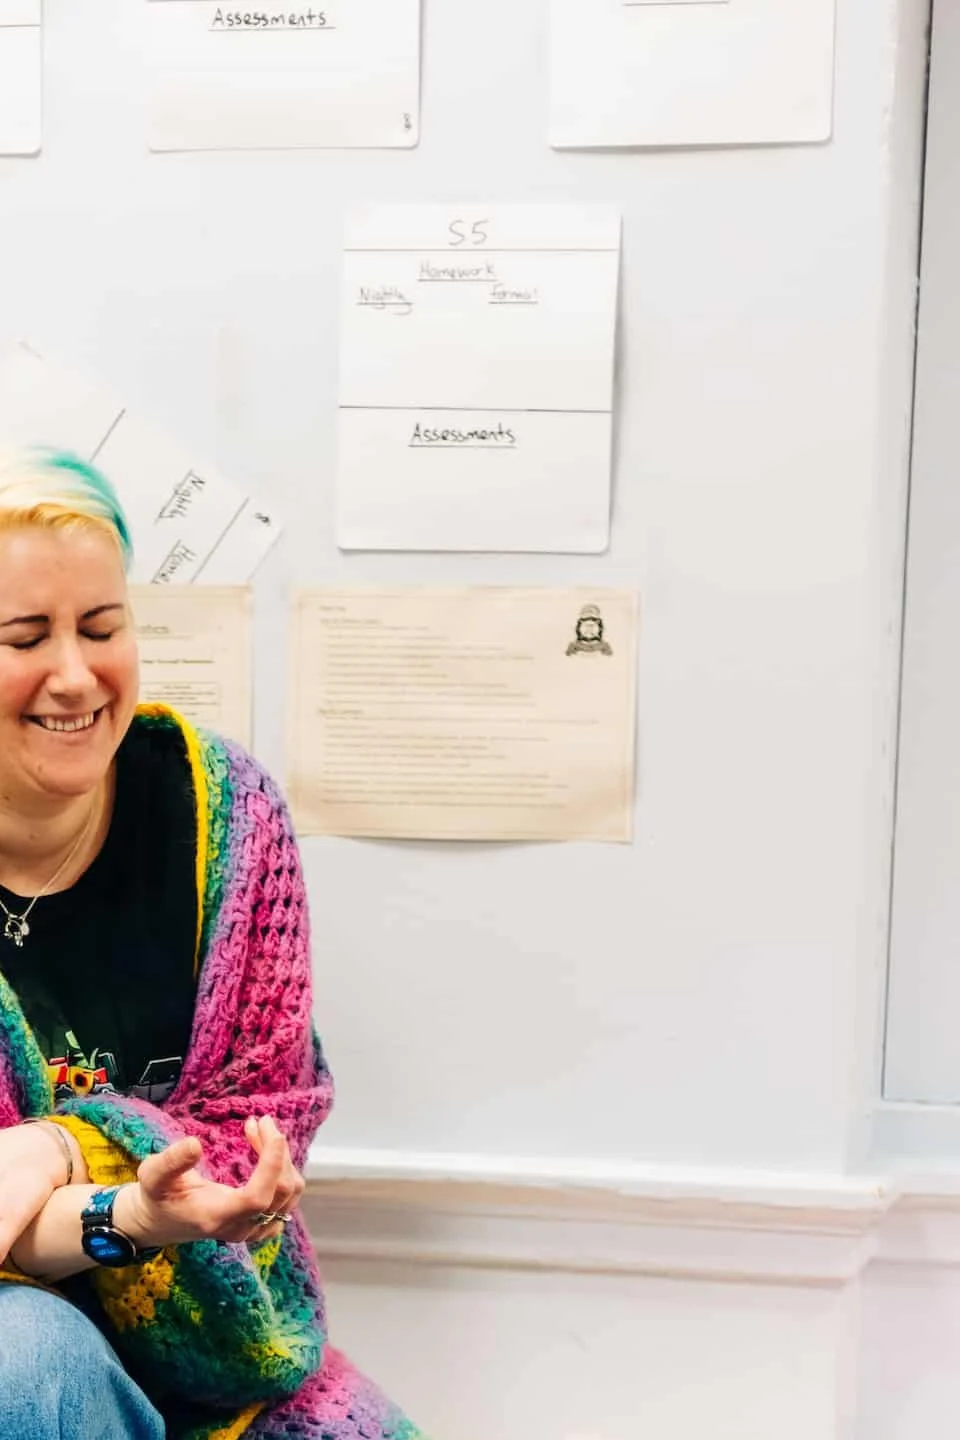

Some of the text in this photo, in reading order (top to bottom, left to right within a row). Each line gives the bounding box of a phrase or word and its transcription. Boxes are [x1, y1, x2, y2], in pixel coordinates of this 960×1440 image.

[211, 7, 328, 28] Assessments
[419, 261, 496, 280] Homework
[410, 423, 517, 445] Assessments
